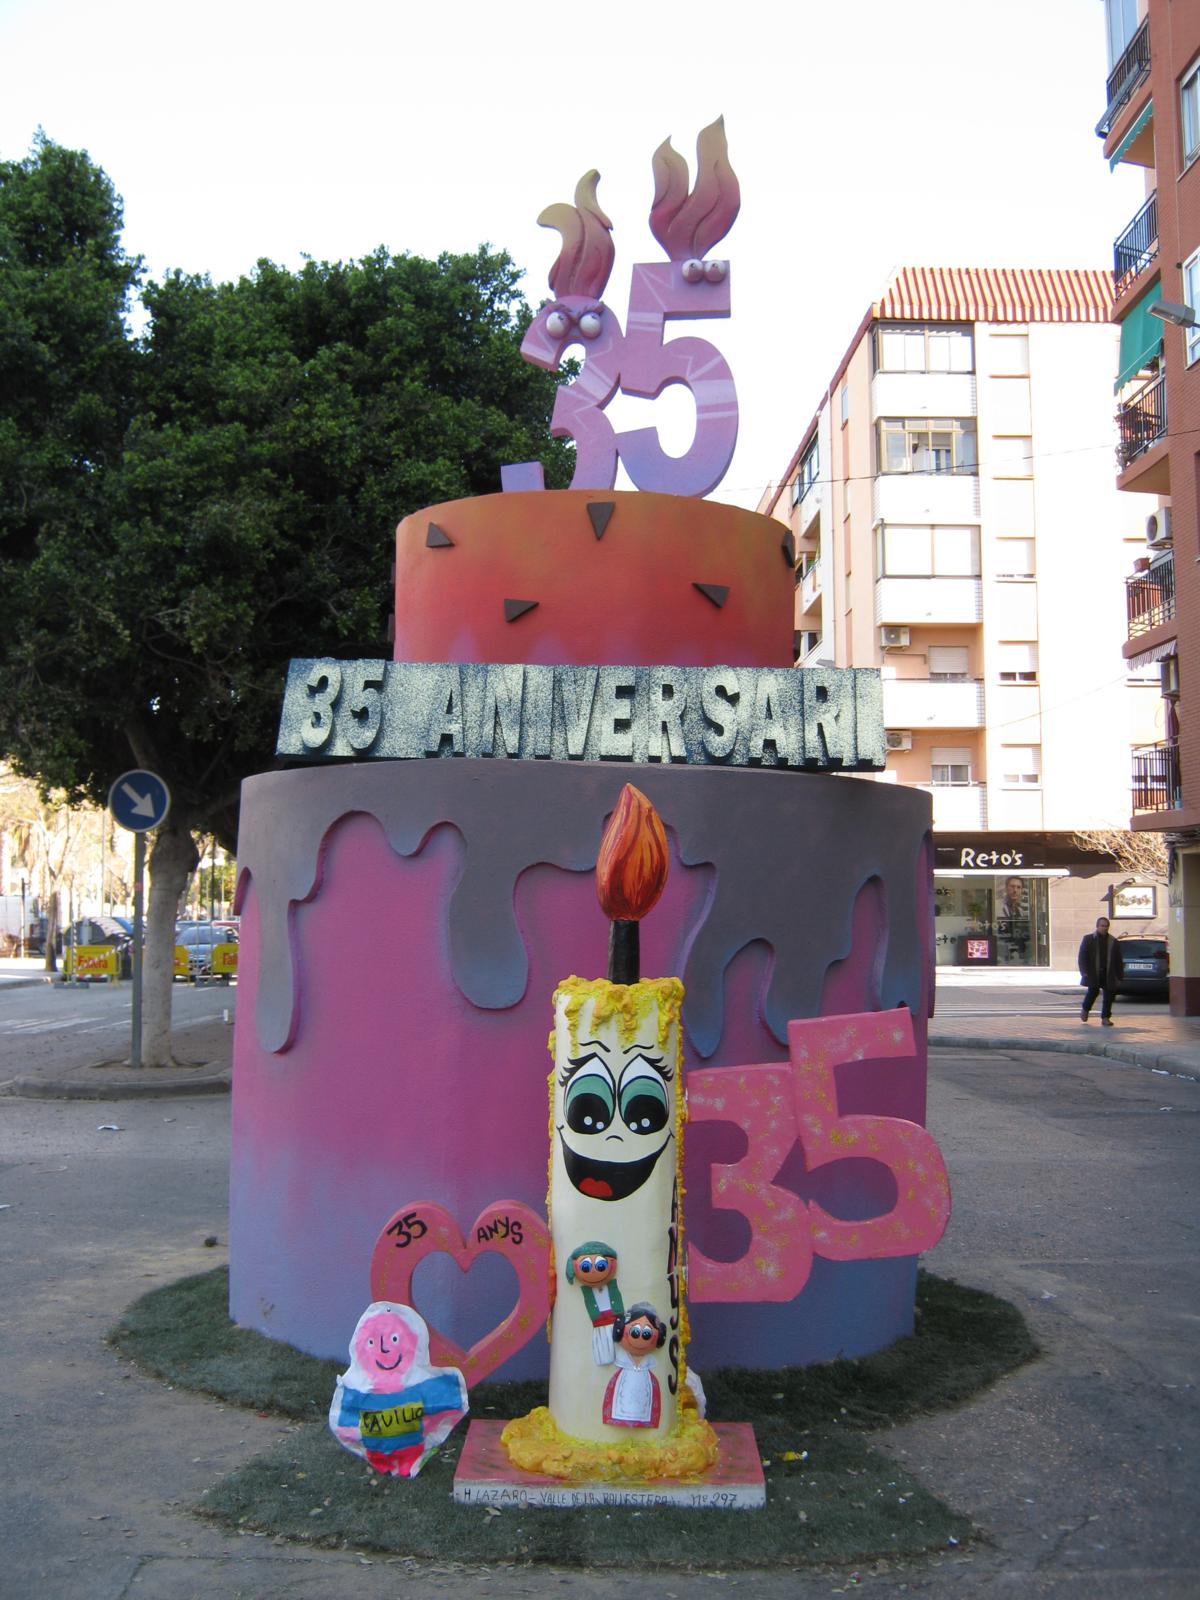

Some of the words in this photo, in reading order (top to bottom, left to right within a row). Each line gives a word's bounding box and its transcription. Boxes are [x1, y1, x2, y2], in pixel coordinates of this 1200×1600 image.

[301, 658, 386, 750] 35
[425, 663, 877, 767] ANIVERSARI
[961, 848, 1023, 867] Reto's
[687, 1007, 951, 1303] 35
[387, 1212, 428, 1248] 35
[477, 1216, 523, 1245] ANYS
[712, 1493, 737, 1507] 297
